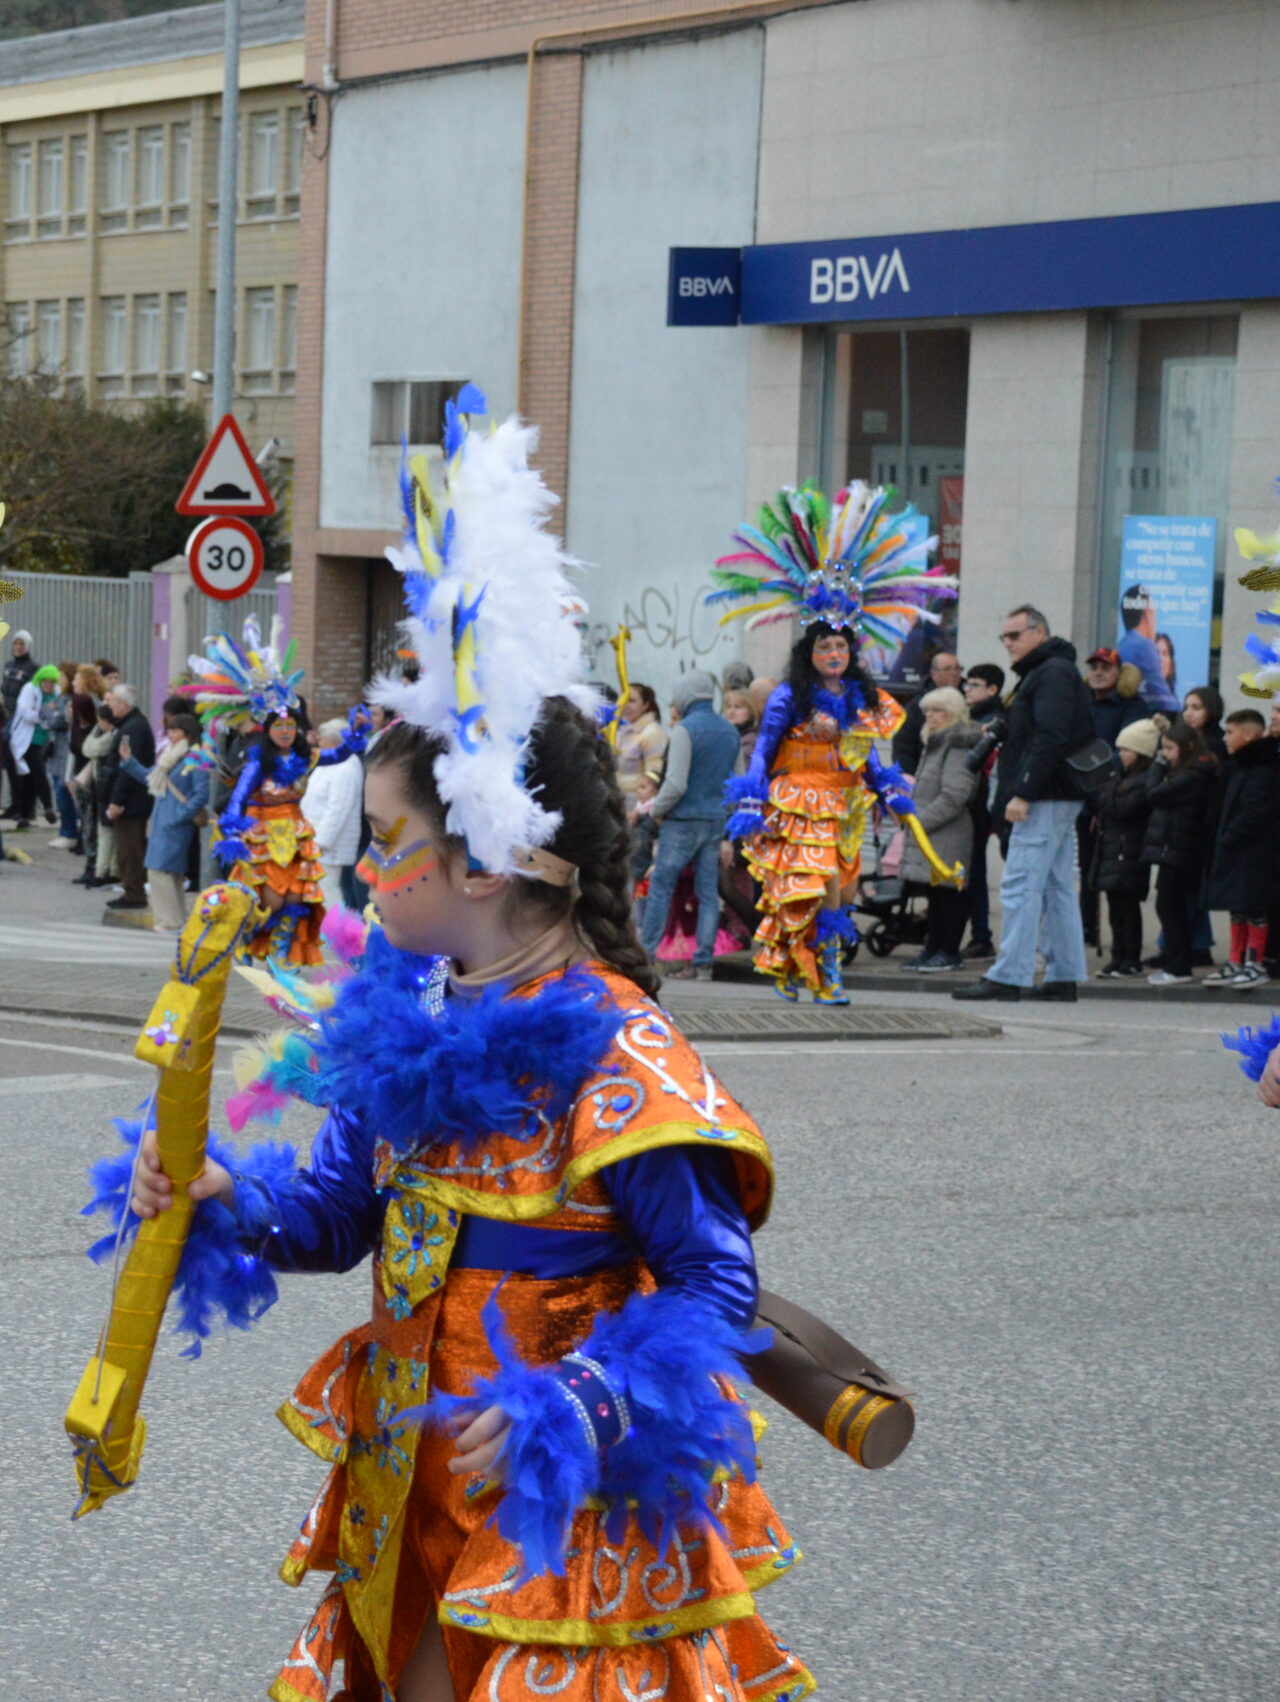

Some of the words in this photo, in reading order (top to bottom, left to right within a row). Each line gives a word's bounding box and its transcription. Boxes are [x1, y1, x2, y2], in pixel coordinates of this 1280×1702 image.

[810, 248, 910, 304] BBVA
[679, 275, 734, 297] BBVA
[1170, 524, 1197, 536] trata
[1198, 522, 1211, 537] de
[1126, 539, 1172, 554] competir
[1174, 541, 1195, 552] con
[207, 545, 245, 572] 30
[1137, 554, 1165, 566] otros
[1137, 568, 1162, 580] trata
[1163, 567, 1177, 581] de
[1138, 583, 1187, 599] competir
[1188, 586, 1208, 598] con
[1160, 600, 1180, 614] que
